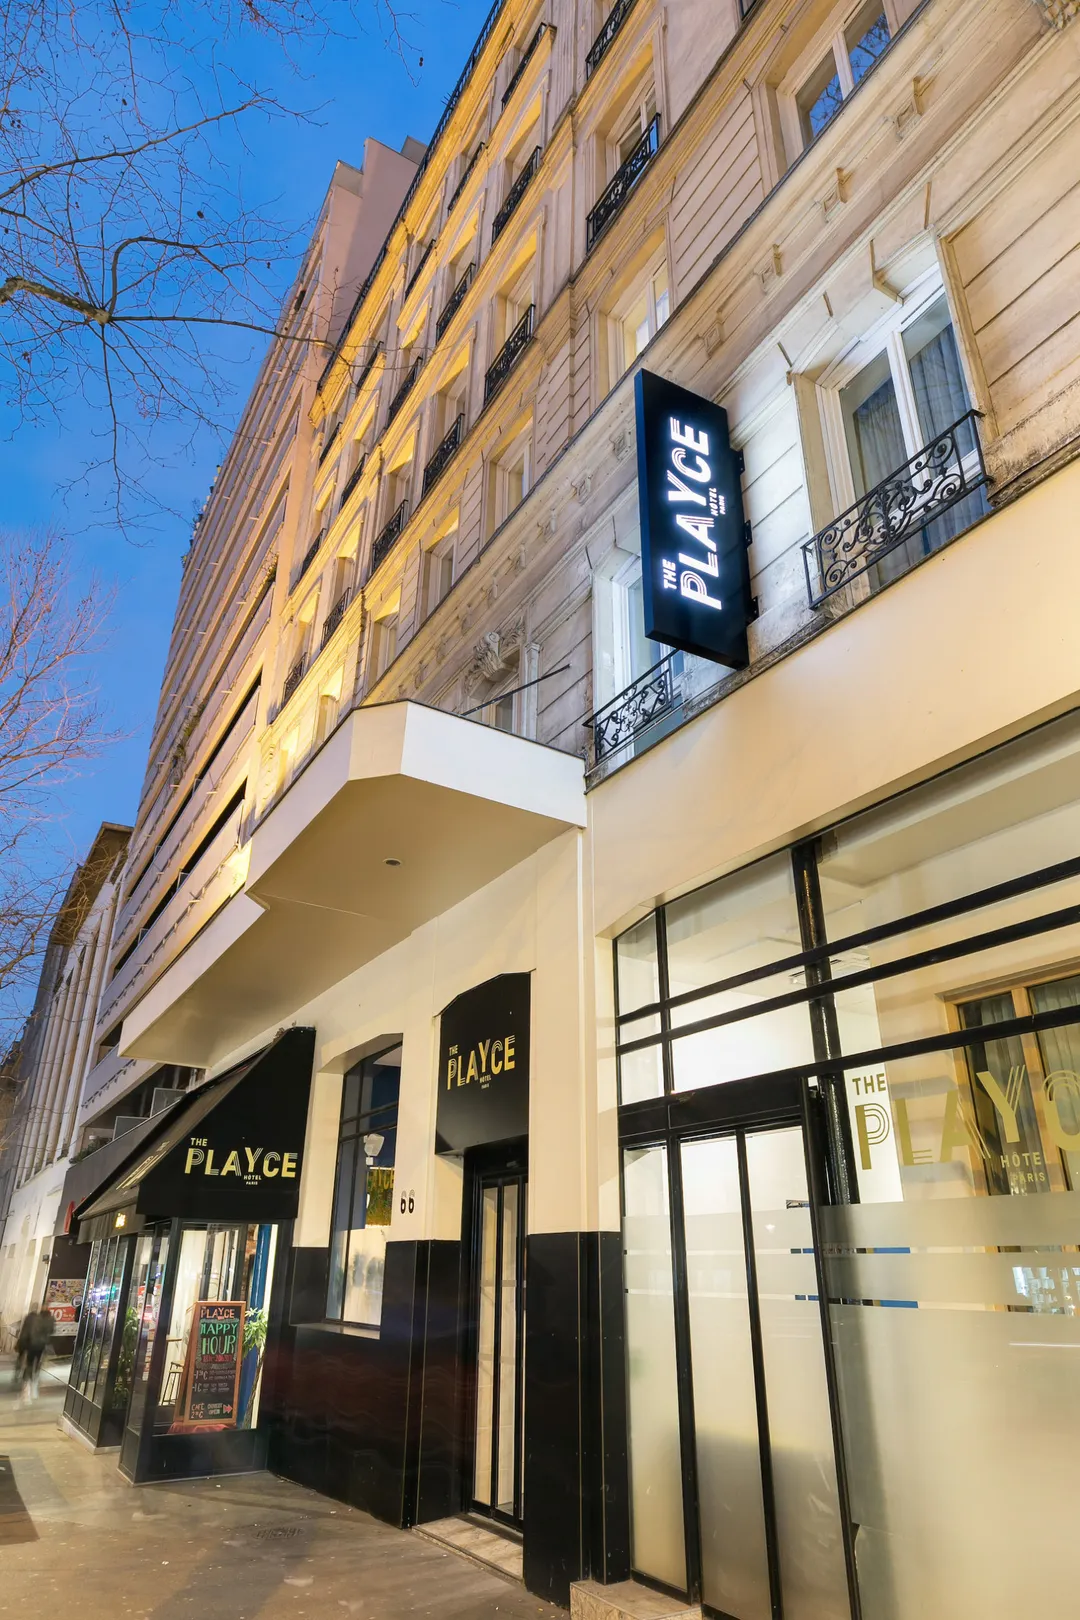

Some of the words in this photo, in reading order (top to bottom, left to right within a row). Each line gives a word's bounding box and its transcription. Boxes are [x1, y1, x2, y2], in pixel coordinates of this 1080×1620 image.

[667, 416, 723, 611] PLAYCE
[662, 558, 677, 589] THE
[449, 1044, 459, 1057] THE
[447, 1034, 516, 1091] PLAYCE
[852, 1072, 886, 1096] THE
[190, 1137, 208, 1147] THE
[184, 1146, 299, 1178] PLAYCE
[1013, 1172, 1047, 1184] PARIS
[400, 1188, 415, 1214] 66
[201, 1307, 235, 1318] PLAYCE
[200, 1323, 238, 1335] HAPPY
[202, 1335, 236, 1355] HOUR
